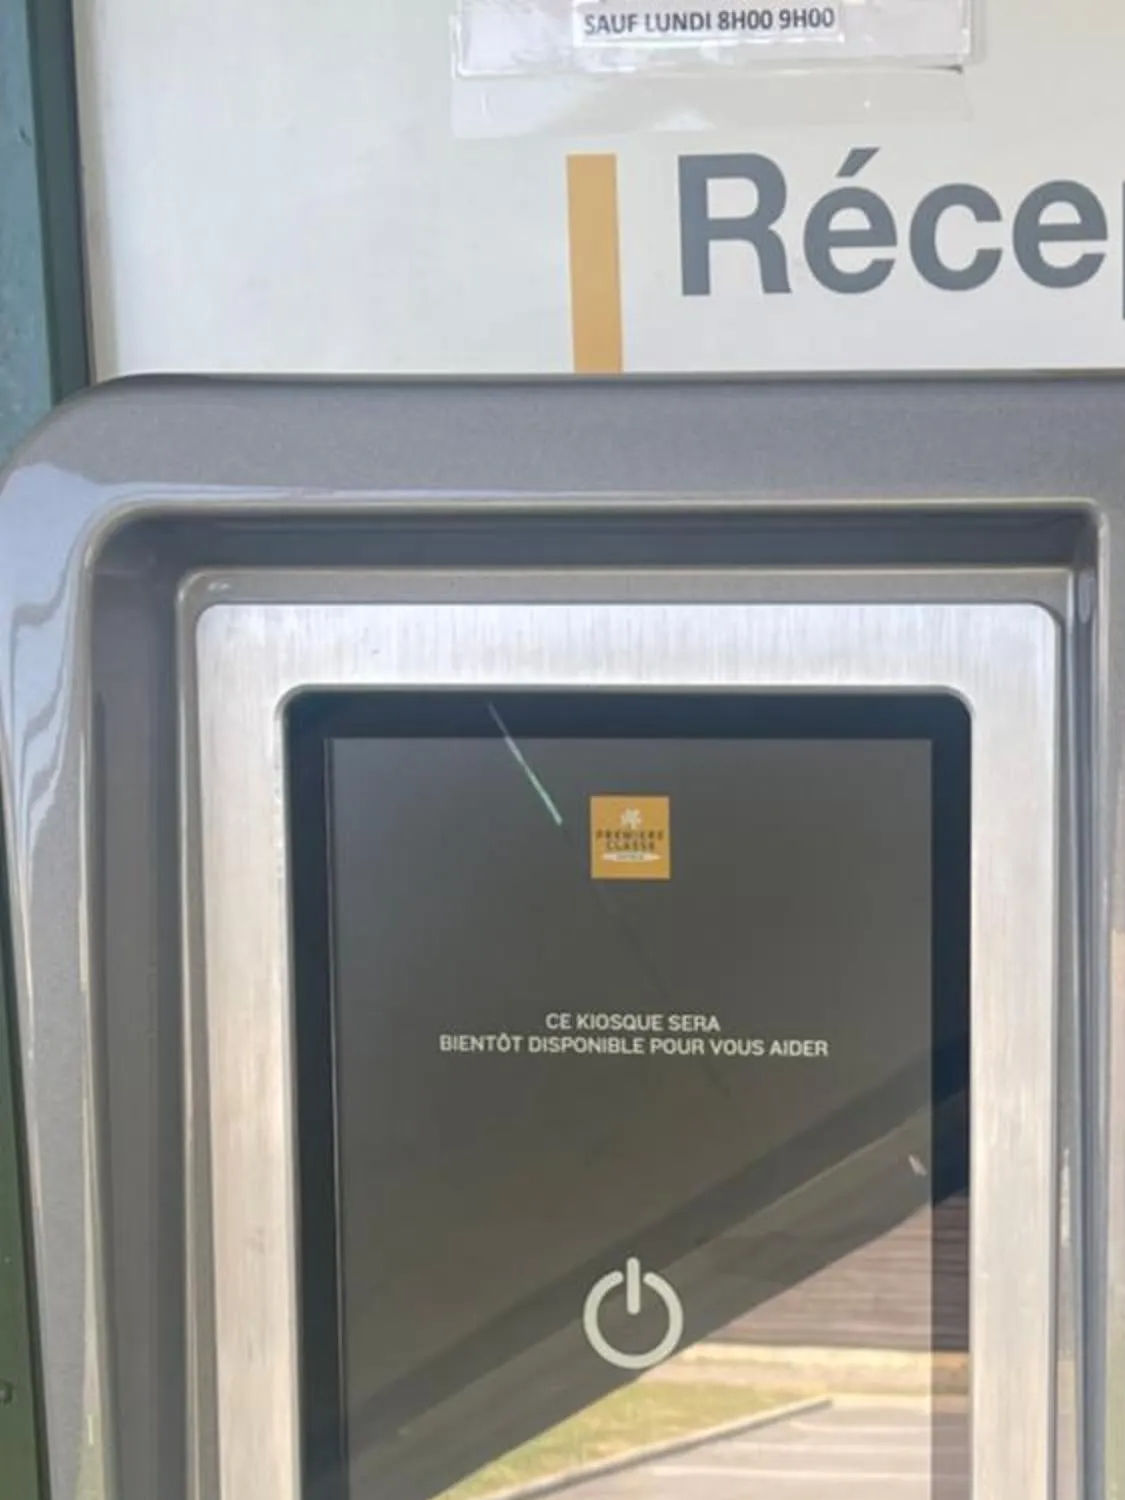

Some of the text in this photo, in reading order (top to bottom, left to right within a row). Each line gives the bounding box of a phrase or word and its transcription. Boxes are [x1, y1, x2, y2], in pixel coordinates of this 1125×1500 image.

[584, 7, 835, 35] SAUF LUNDI 8H00 9H00
[545, 1013, 721, 1032] CE KIOSQUE SERA
[439, 1033, 829, 1057] BIENTÔT DISPONIBLE POUR VOUS AIDER
